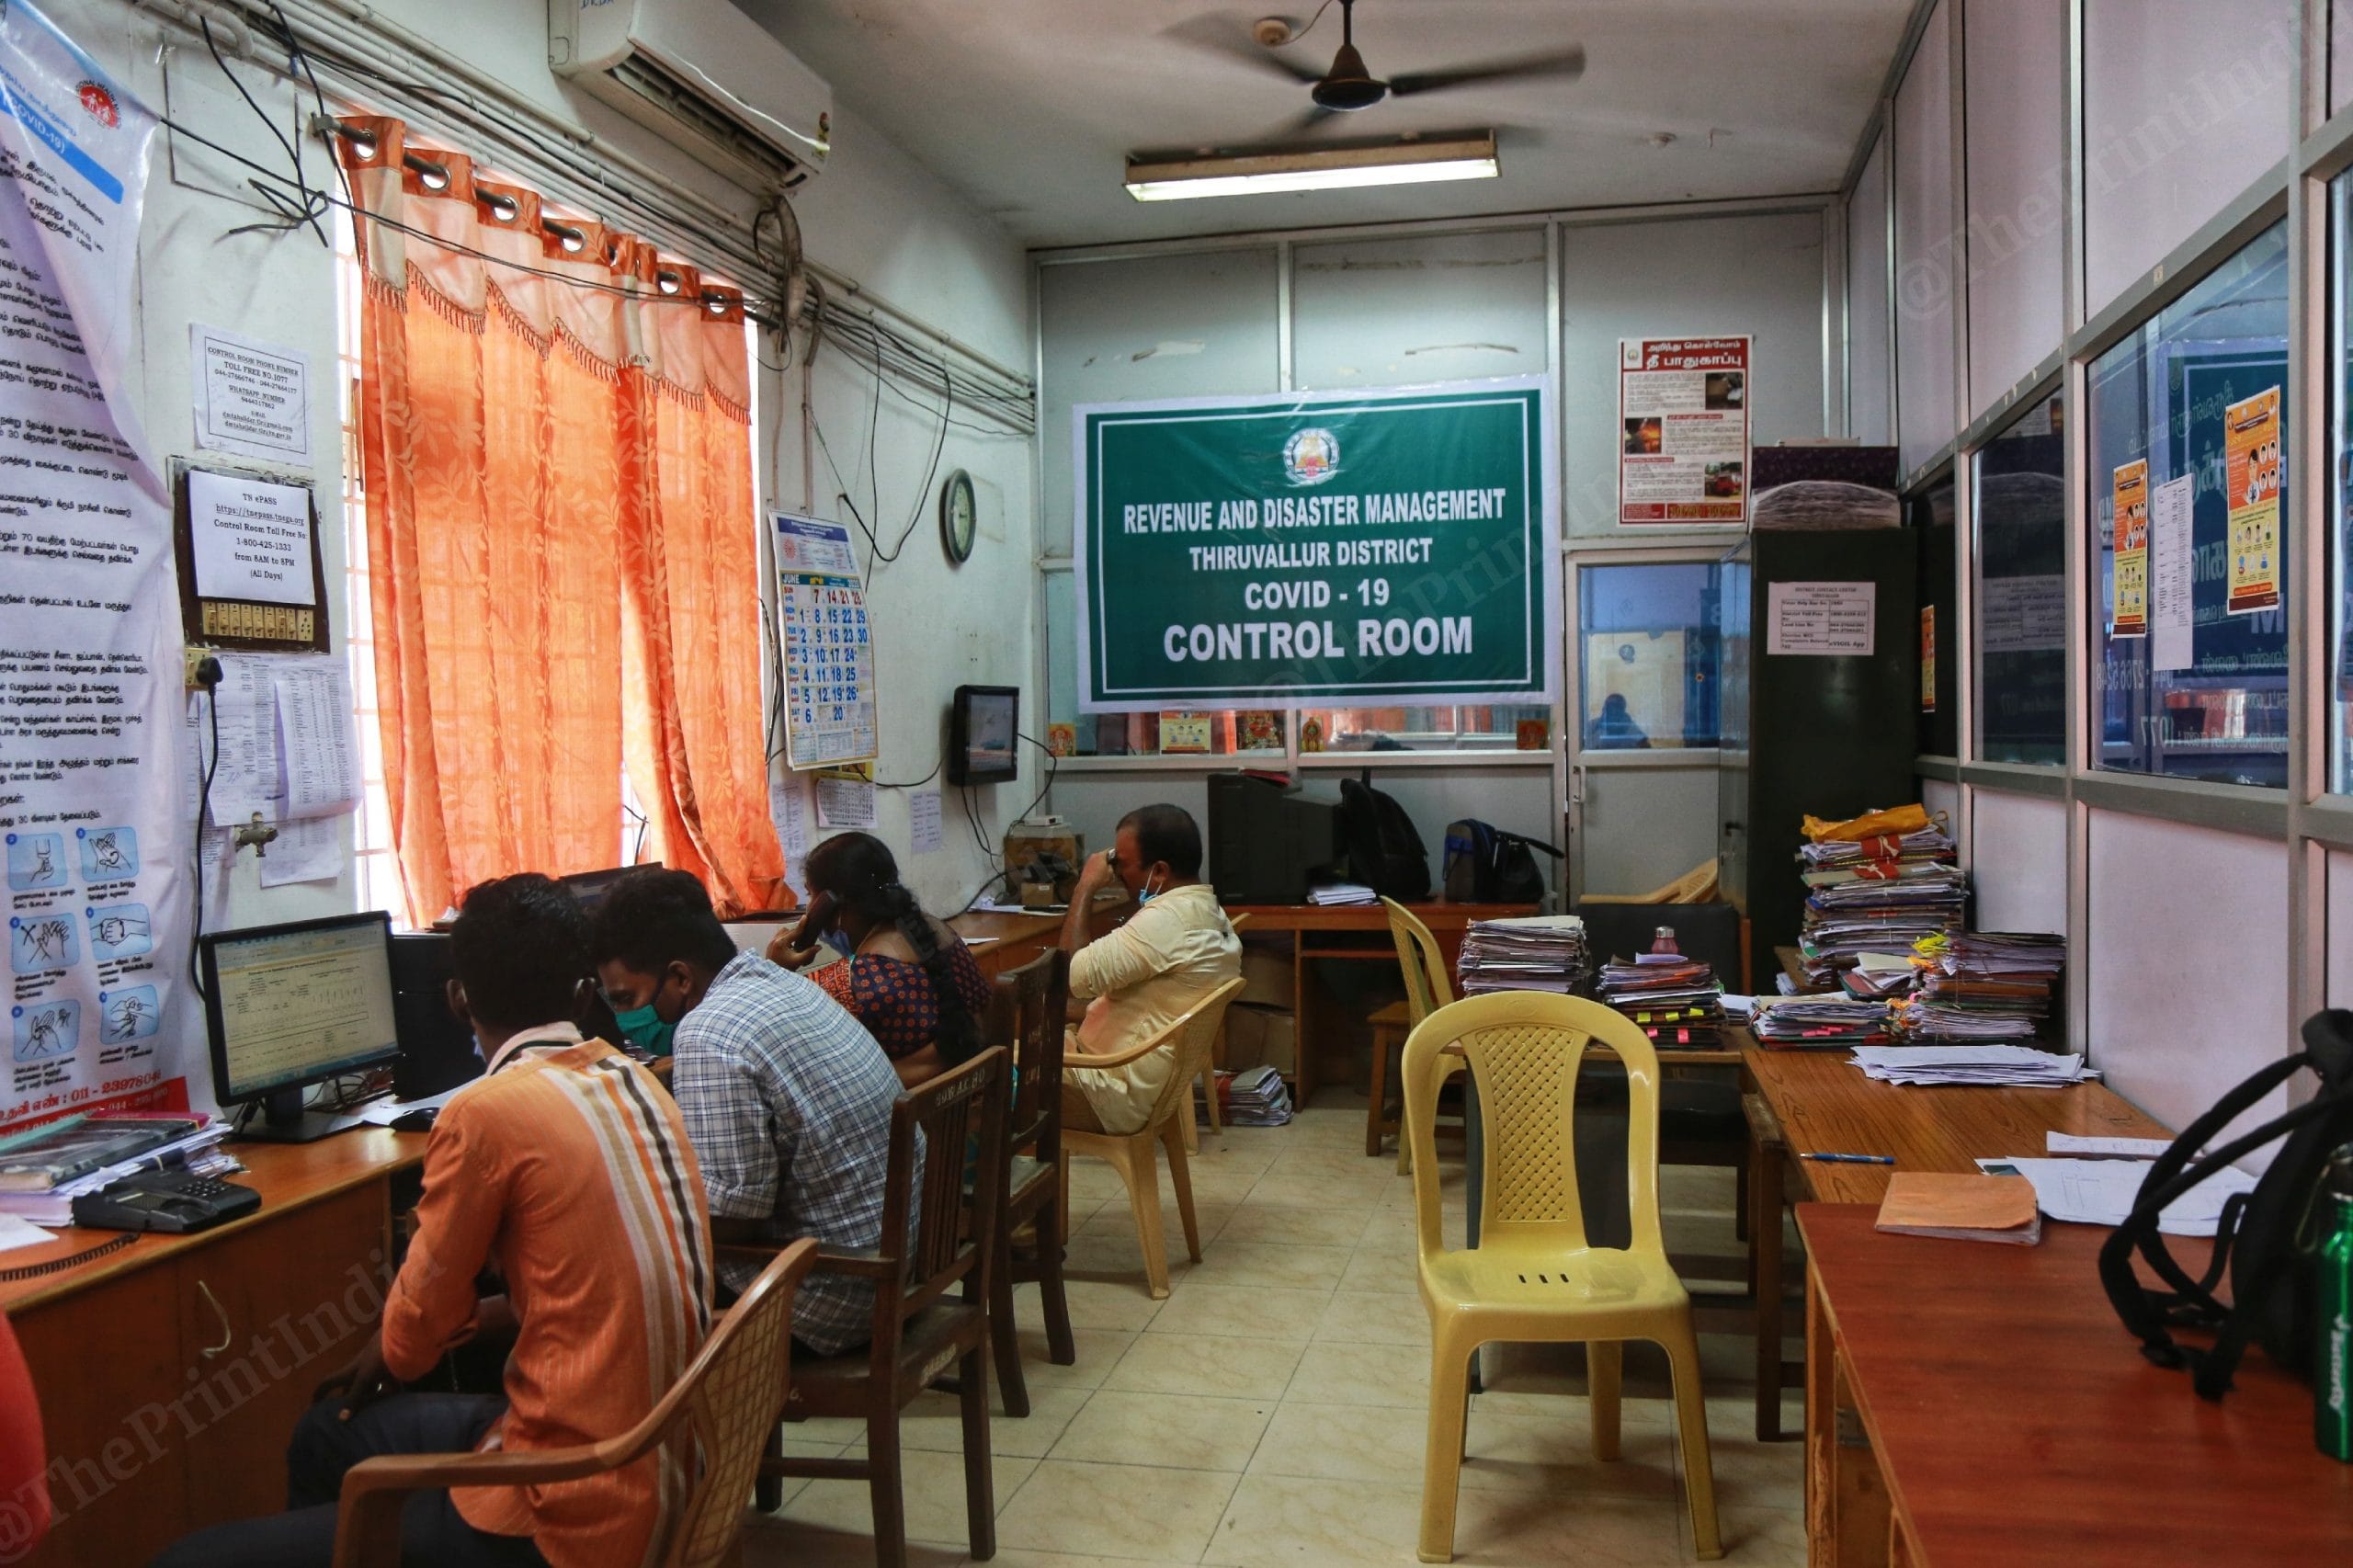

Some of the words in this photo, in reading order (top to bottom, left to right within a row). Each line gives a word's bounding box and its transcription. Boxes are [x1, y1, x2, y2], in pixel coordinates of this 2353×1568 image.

[208, 347, 235, 359] CONTROL
[237, 355, 255, 364] ROOM
[256, 359, 275, 369] PHONE
[277, 364, 299, 375] NUMBER
[1663, 352, 1742, 368] பாதுகாப்பு
[224, 361, 241, 371] TOLL
[244, 366, 260, 376] FREE
[228, 385, 259, 397] WHATSAPP
[263, 393, 285, 403] NUMBER
[8, 429, 19, 438] 30
[243, 493, 253, 502] TN
[255, 495, 278, 506] ePASS
[1124, 500, 1212, 534] REVENUE
[1218, 498, 1258, 529] AND
[1264, 494, 1358, 528] DISASTER
[1365, 488, 1506, 524] MANAGEMENT
[214, 519, 243, 530] Control
[244, 523, 265, 533] Room
[267, 526, 279, 535] Toll
[282, 528, 296, 538] Free
[22, 533, 33, 541] 70
[236, 537, 292, 551] 1-800-425-1333
[234, 552, 252, 562] from
[254, 554, 269, 563] 8AM
[271, 555, 279, 564] to
[280, 557, 295, 566] 8PM
[1189, 540, 1331, 571] THIRUVALLUR
[1337, 537, 1433, 567] DISTRICT
[783, 574, 800, 585] JUNE
[813, 589, 820, 604] 7
[827, 591, 837, 604] 14
[840, 590, 850, 604] 21
[1245, 582, 1331, 610] COVID
[1357, 578, 1391, 607] 19
[800, 608, 804, 623] 1
[814, 608, 821, 623] 8
[828, 609, 838, 623] 15
[842, 609, 853, 623] 22
[856, 609, 866, 623] 29
[801, 629, 807, 643] 2
[816, 629, 822, 643] 9
[829, 629, 839, 643] 16
[843, 629, 854, 643] 23
[858, 629, 868, 643] 30
[1164, 621, 1345, 663] CONTROL
[1358, 616, 1472, 657] ROOM
[802, 649, 808, 663] 3
[815, 648, 825, 663] 10
[831, 648, 840, 662] 17
[845, 648, 855, 662] 24
[803, 669, 809, 683] 4
[816, 667, 825, 682] 11
[832, 667, 842, 681] 18
[846, 667, 856, 681] 25
[804, 688, 811, 703] 5
[818, 687, 828, 702] 12
[833, 687, 843, 701] 19
[847, 686, 857, 700] 26
[805, 709, 812, 723] 6
[834, 706, 844, 721] 20
[18, 815, 28, 824] 30
